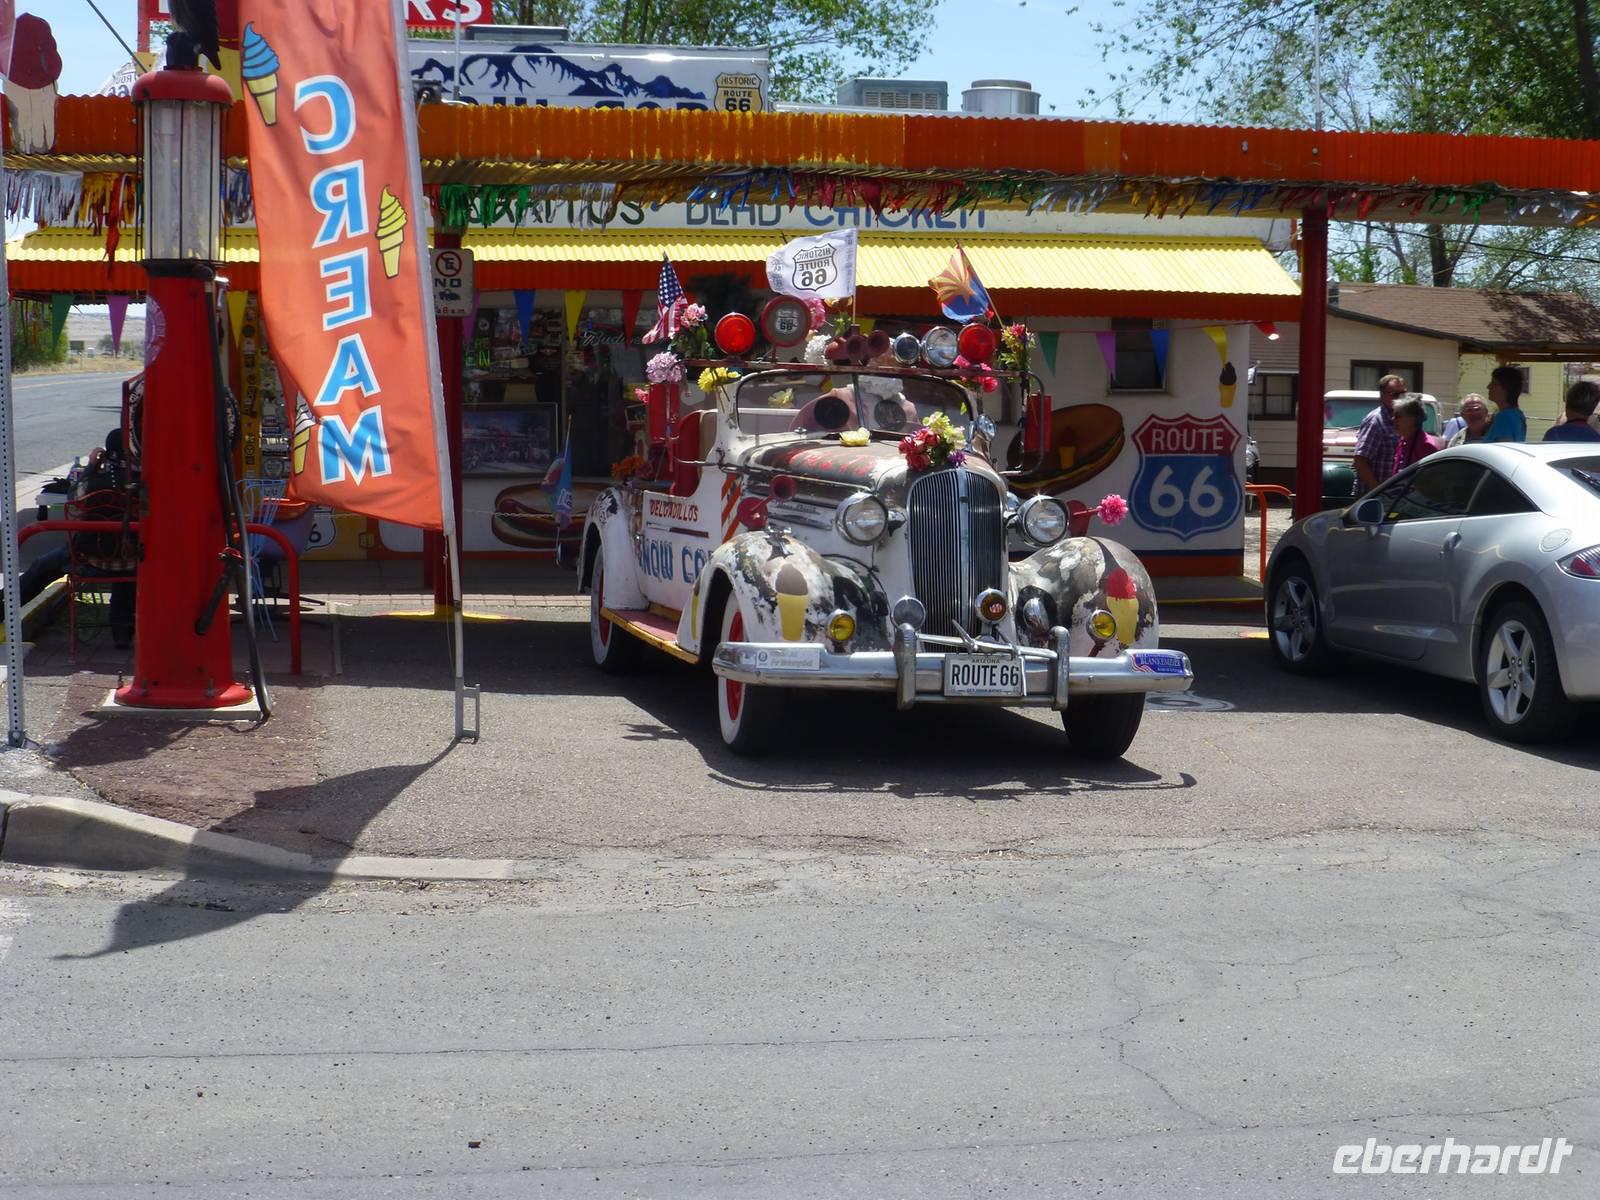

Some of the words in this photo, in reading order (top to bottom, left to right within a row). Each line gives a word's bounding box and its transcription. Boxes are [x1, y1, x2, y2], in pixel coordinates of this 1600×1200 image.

[720, 76, 758, 86] HISTORIC
[723, 90, 753, 98] ROUTE
[725, 97, 751, 112] 66
[434, 278, 462, 288] NO
[1152, 428, 1225, 451] ROUTE
[1149, 464, 1224, 518] 66
[650, 499, 699, 522] DELGADILLOS
[951, 663, 998, 686] ROUTE
[1000, 664, 1019, 687] 66
